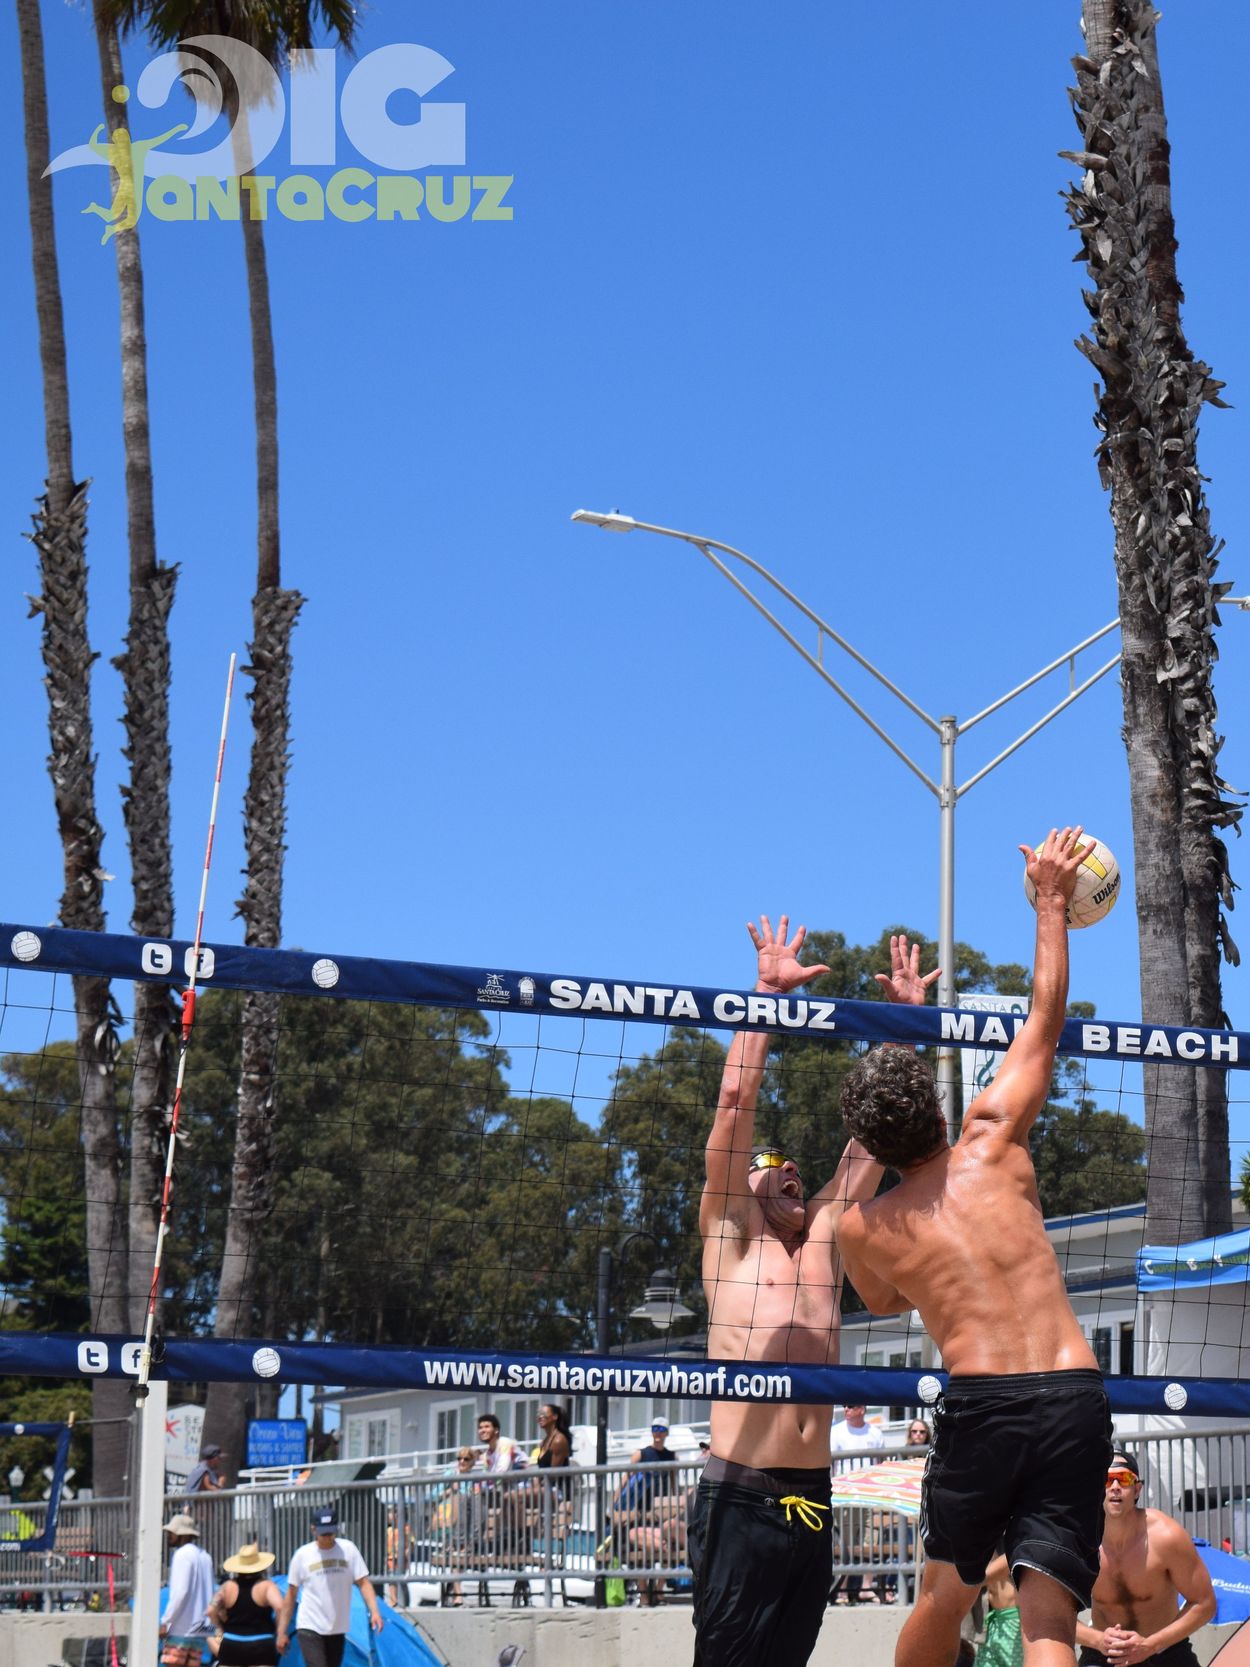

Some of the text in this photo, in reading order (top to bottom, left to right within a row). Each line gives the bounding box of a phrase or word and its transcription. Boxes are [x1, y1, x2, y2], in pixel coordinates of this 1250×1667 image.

[1092, 873, 1121, 905] Wilson
[549, 979, 701, 1020] SANTA
[713, 993, 836, 1030] CRUZ
[941, 1012, 1059, 1048] MAI
[1082, 1024, 1239, 1062] BEACH
[424, 1360, 792, 1398] www.santacruzwharf.com
